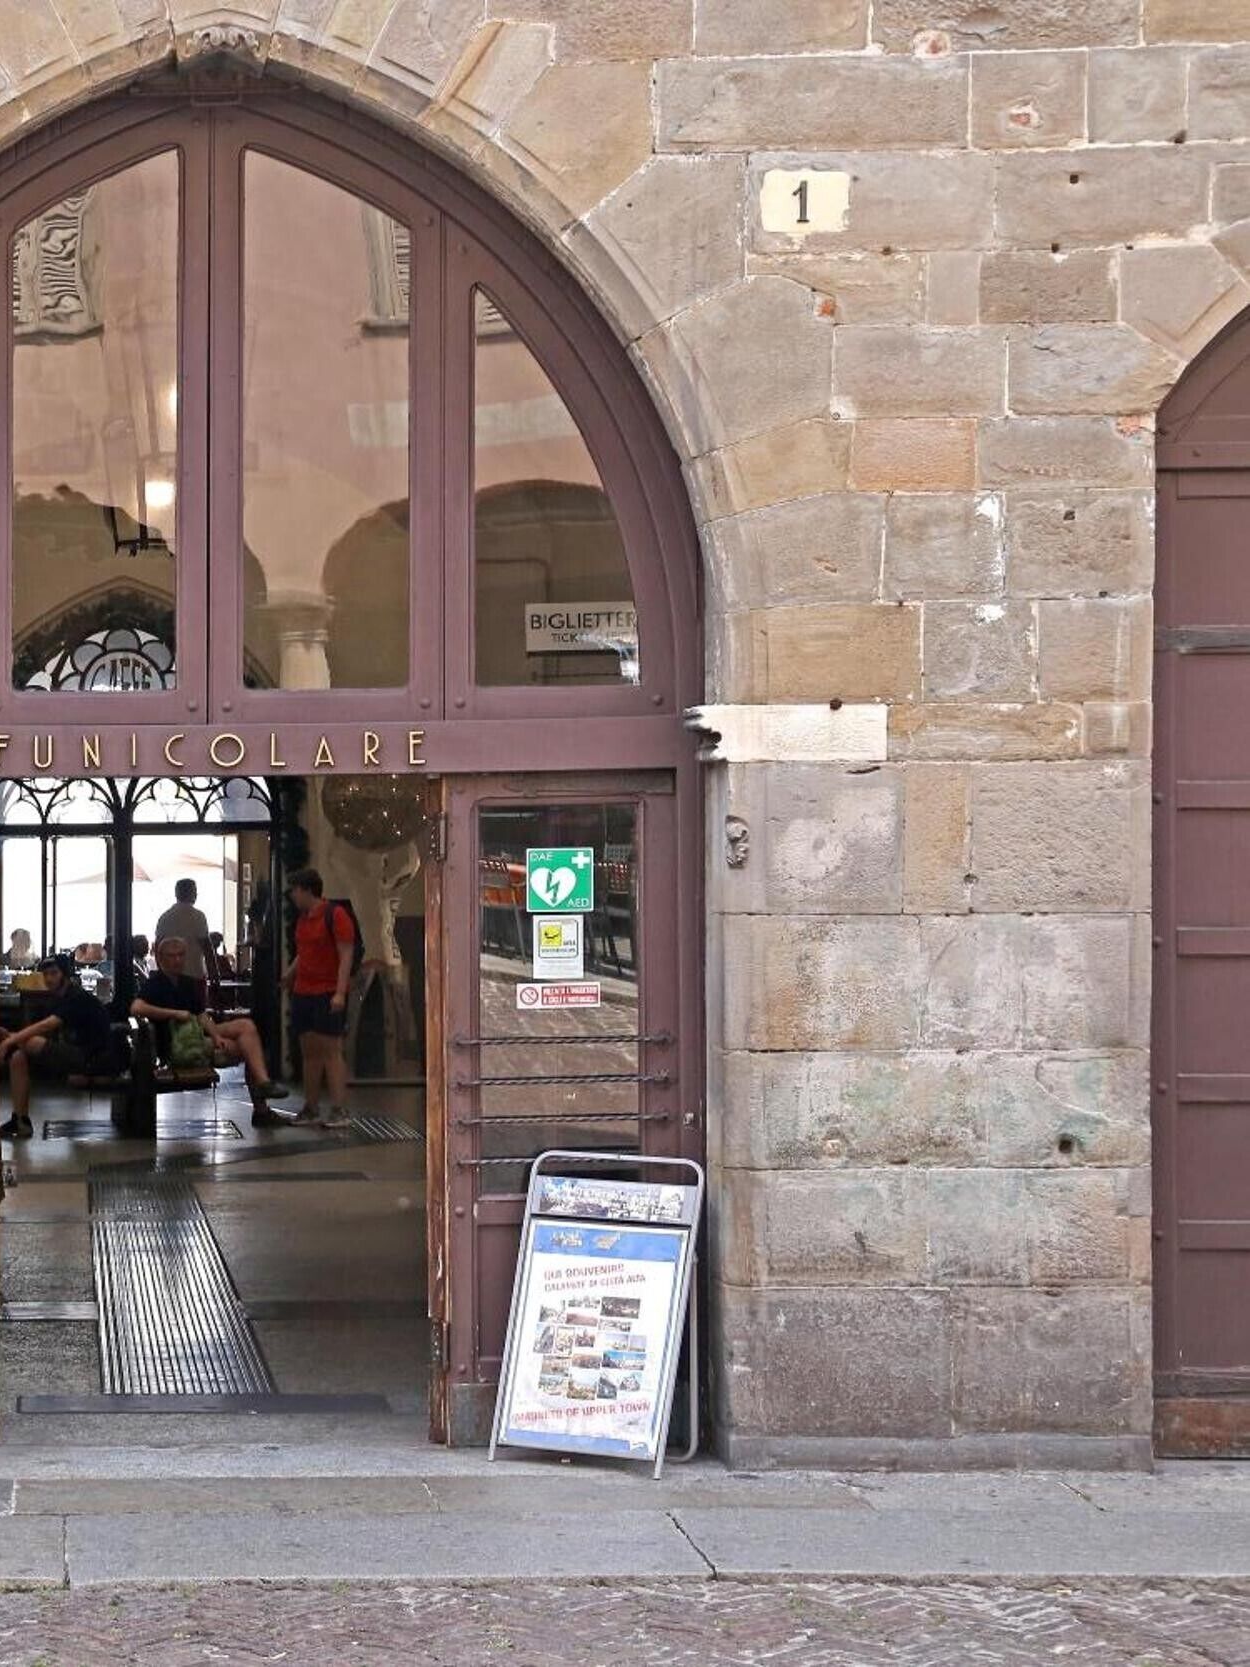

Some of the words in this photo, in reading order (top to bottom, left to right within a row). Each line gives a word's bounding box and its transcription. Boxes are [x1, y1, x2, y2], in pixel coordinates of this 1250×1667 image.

[792, 180, 810, 223] 1
[529, 851, 553, 862] DAE
[567, 898, 590, 908] AED
